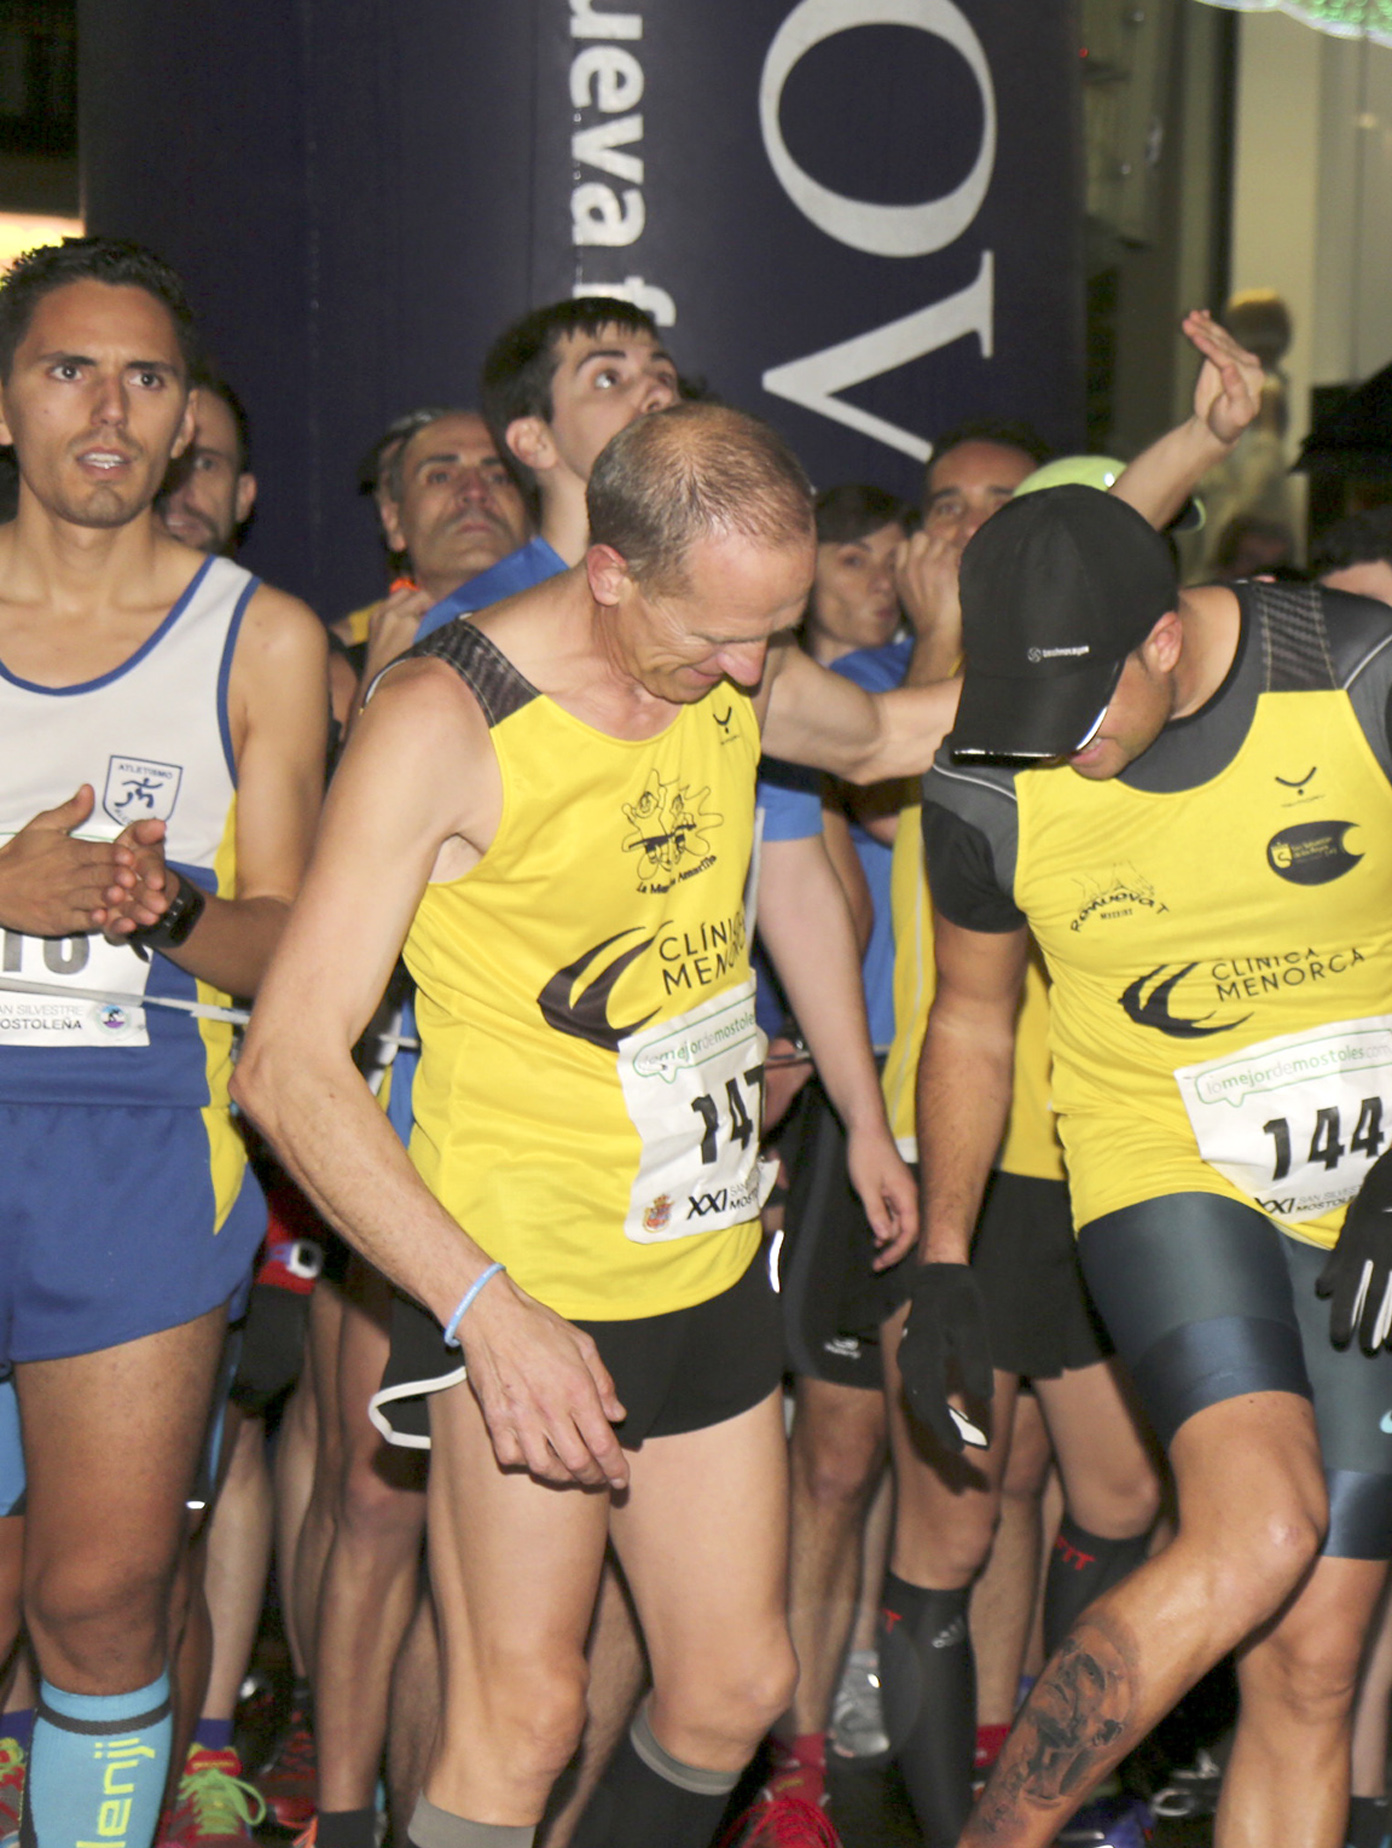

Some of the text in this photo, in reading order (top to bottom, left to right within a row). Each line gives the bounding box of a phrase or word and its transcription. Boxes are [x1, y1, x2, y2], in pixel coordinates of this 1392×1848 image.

[119, 764, 173, 779] ATLETISMO
[1216, 948, 1365, 1002] MENORCA
[0, 1016, 83, 1030] OSTOLEÑA
[16, 1004, 84, 1016] SILVESTRE
[1206, 1043, 1392, 1096] lomejordemostoles.com
[691, 1064, 765, 1165] 147
[1263, 1096, 1385, 1182] 144
[687, 1188, 728, 1221] XXI
